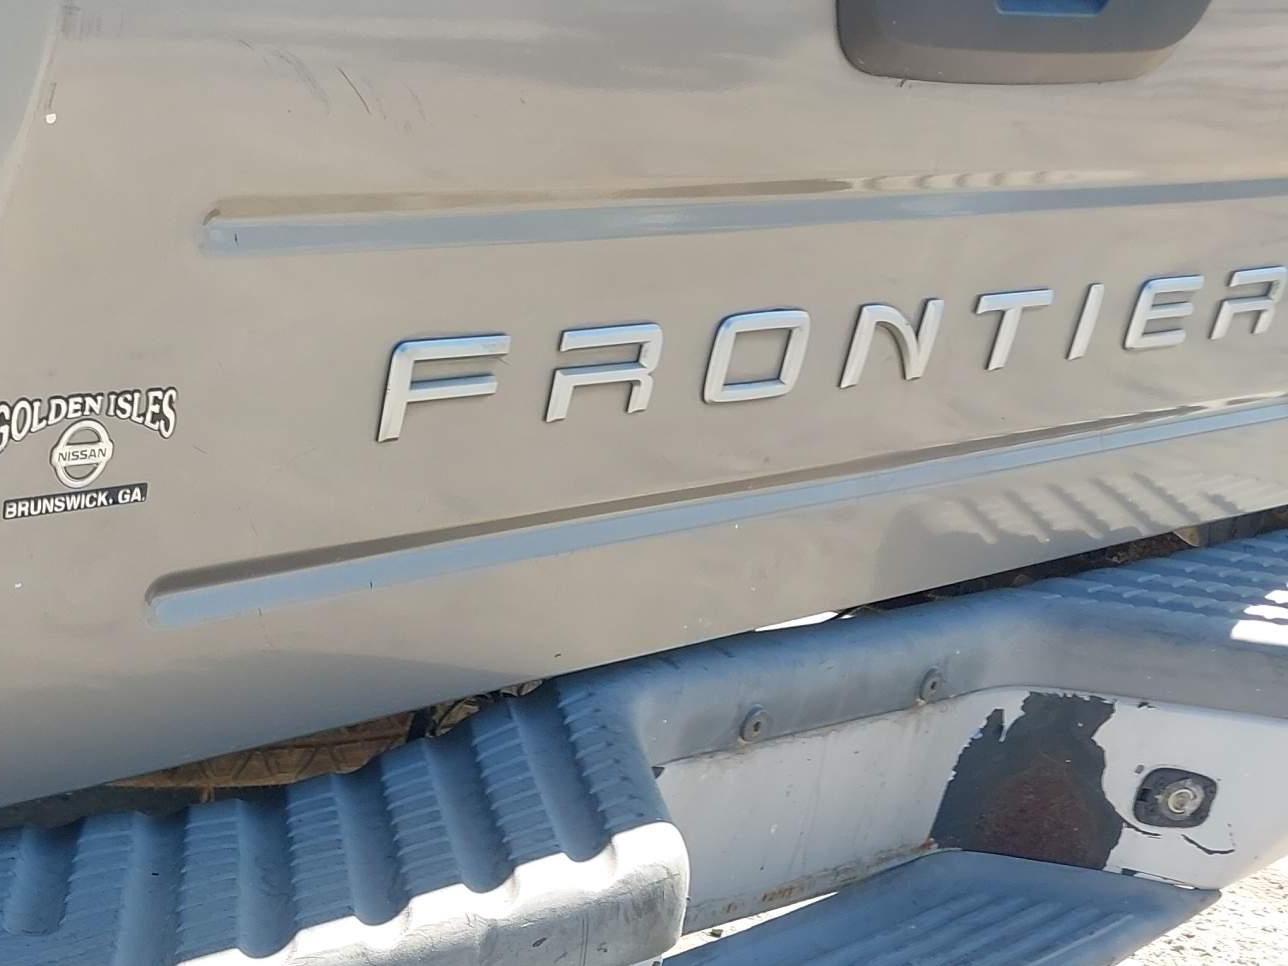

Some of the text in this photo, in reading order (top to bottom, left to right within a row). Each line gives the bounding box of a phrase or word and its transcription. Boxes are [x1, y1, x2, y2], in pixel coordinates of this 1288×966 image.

[376, 264, 1288, 443] FRONTIER
[106, 386, 178, 439] ISLES
[58, 447, 107, 462] NISSAN
